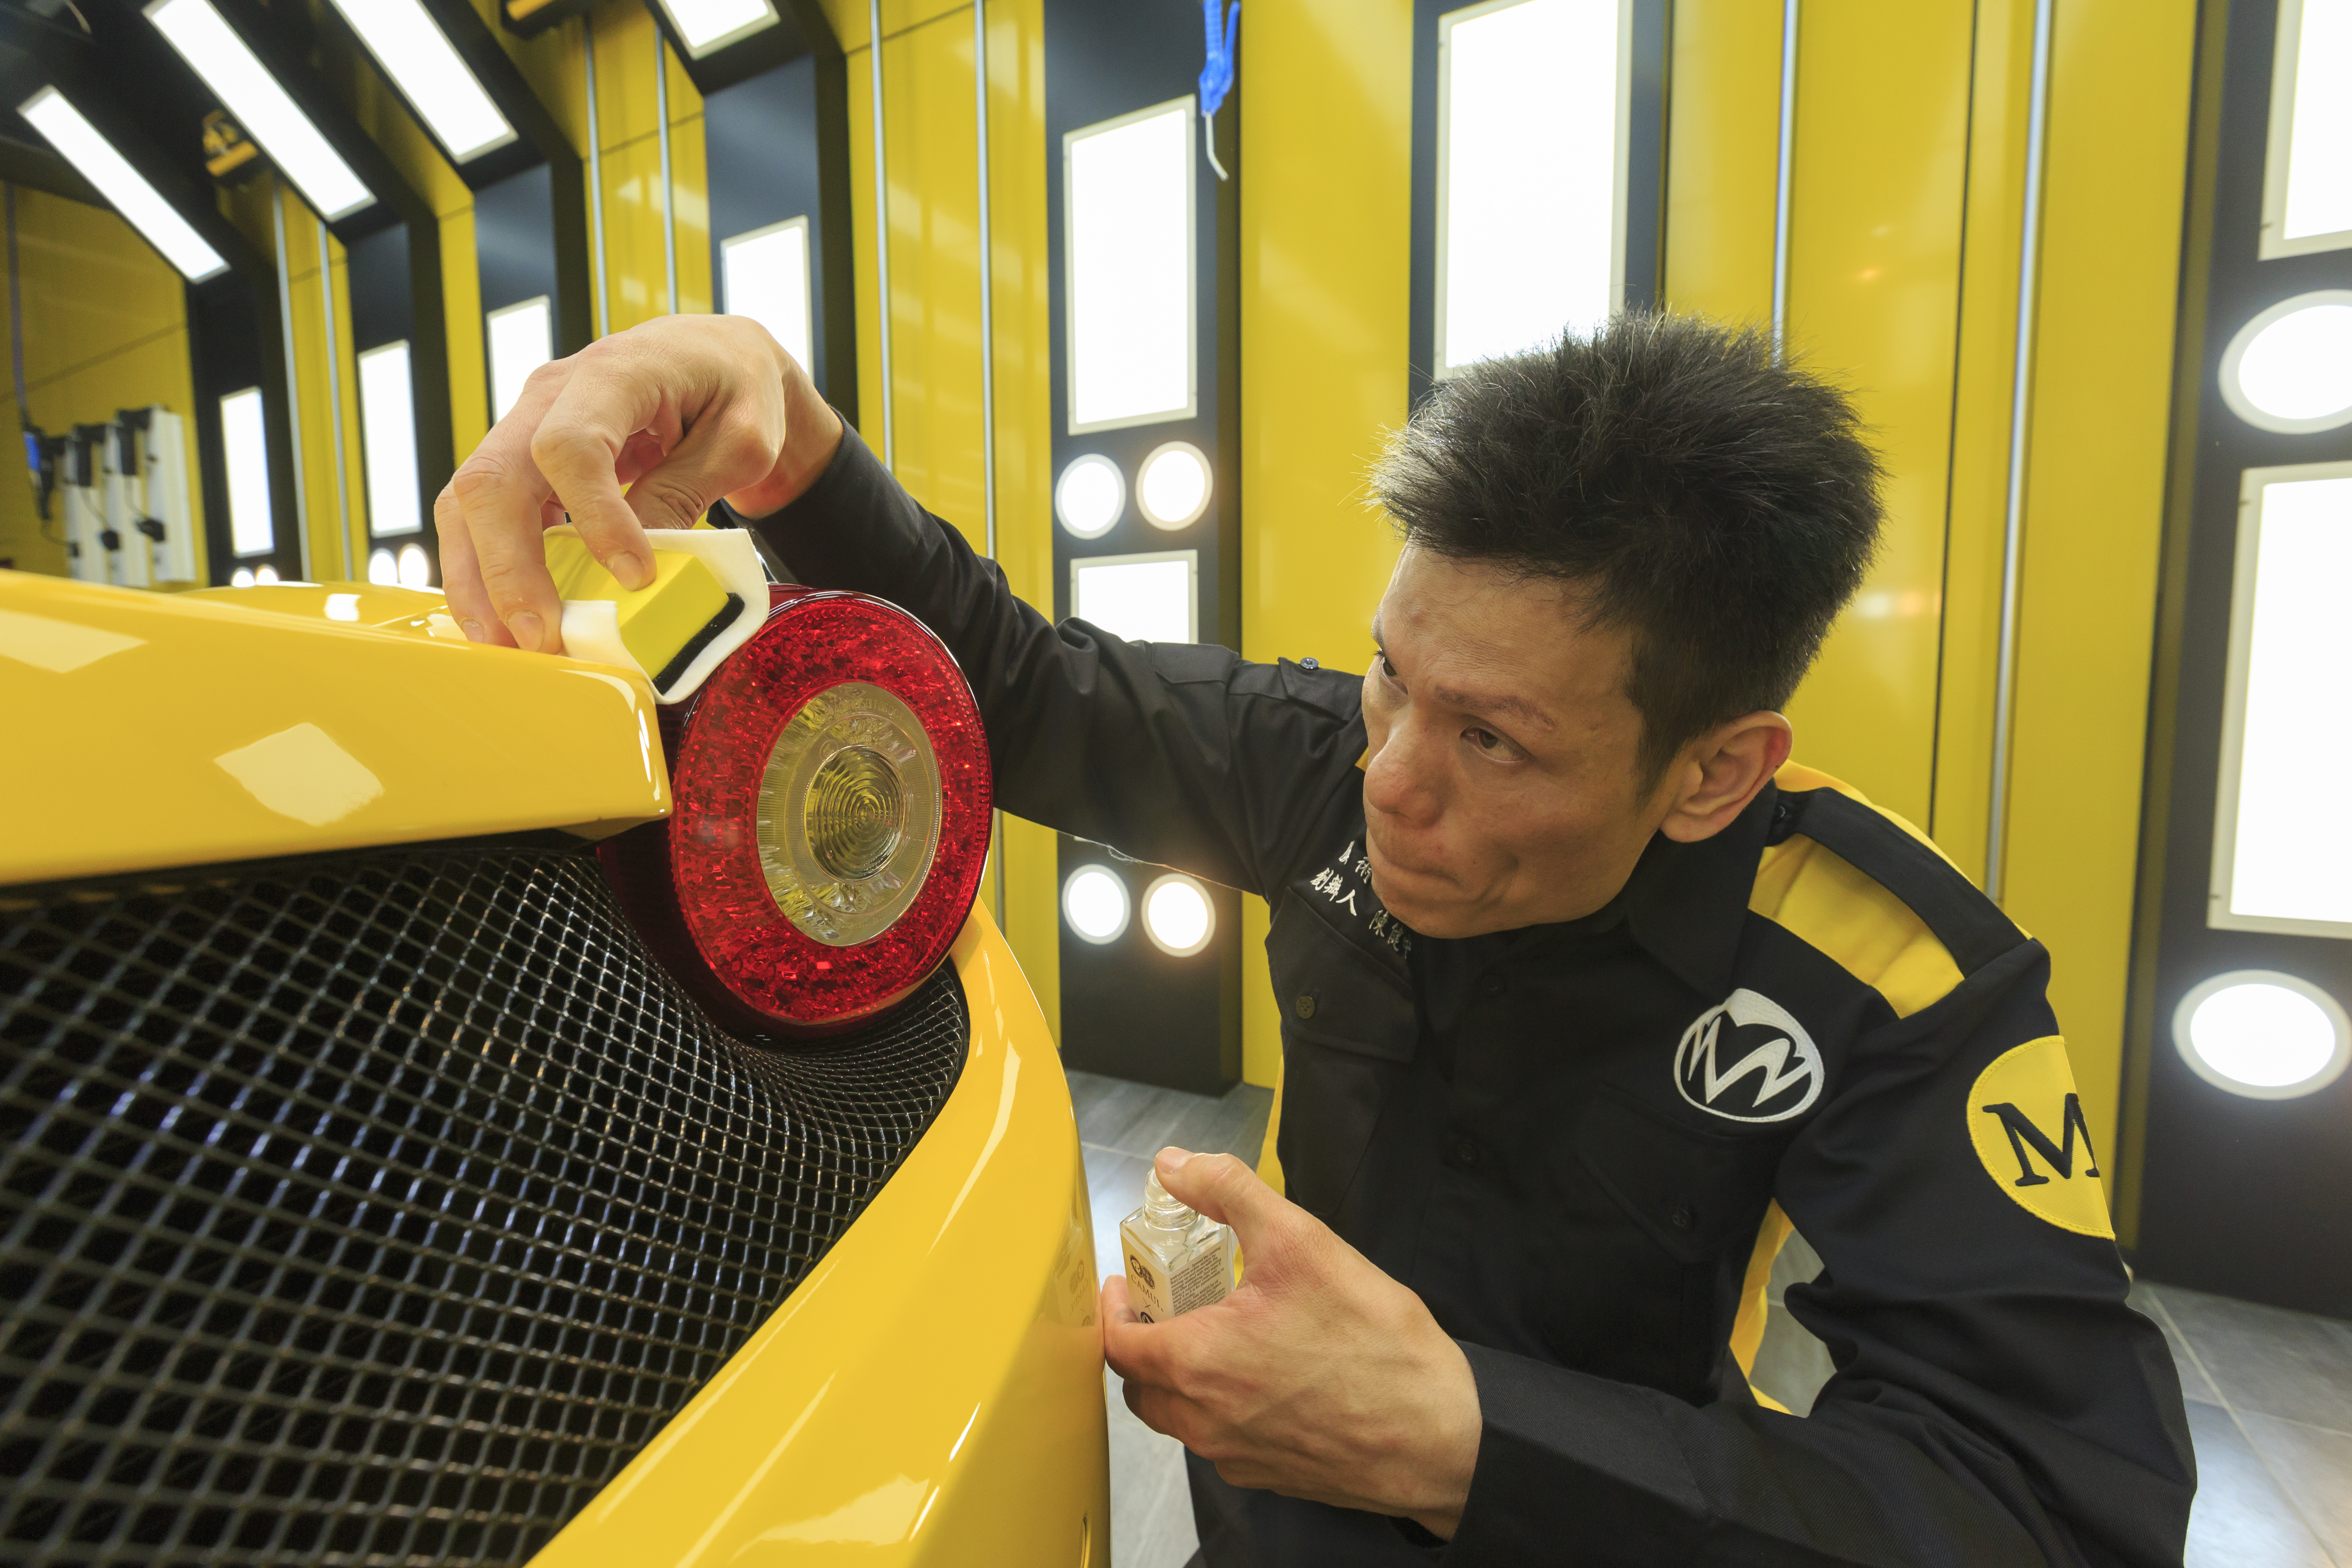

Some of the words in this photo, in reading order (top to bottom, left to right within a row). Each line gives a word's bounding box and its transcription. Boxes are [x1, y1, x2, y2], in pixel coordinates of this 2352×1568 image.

[1982, 1092, 2100, 1187] M
[1171, 1279, 1183, 1290] moving
[1196, 1265, 1205, 1273] down
[1172, 1283, 1184, 1293] sponge
[1184, 1274, 1196, 1285] soaked
[1210, 1257, 1221, 1267] coating
[1172, 1292, 1182, 1301] using
[1174, 1298, 1190, 1312] Directions
[1200, 1285, 1210, 1294] MSDS
[1186, 1298, 1197, 1307] before
[1197, 1292, 1205, 1300] using
[1206, 1287, 1225, 1302] temperature
